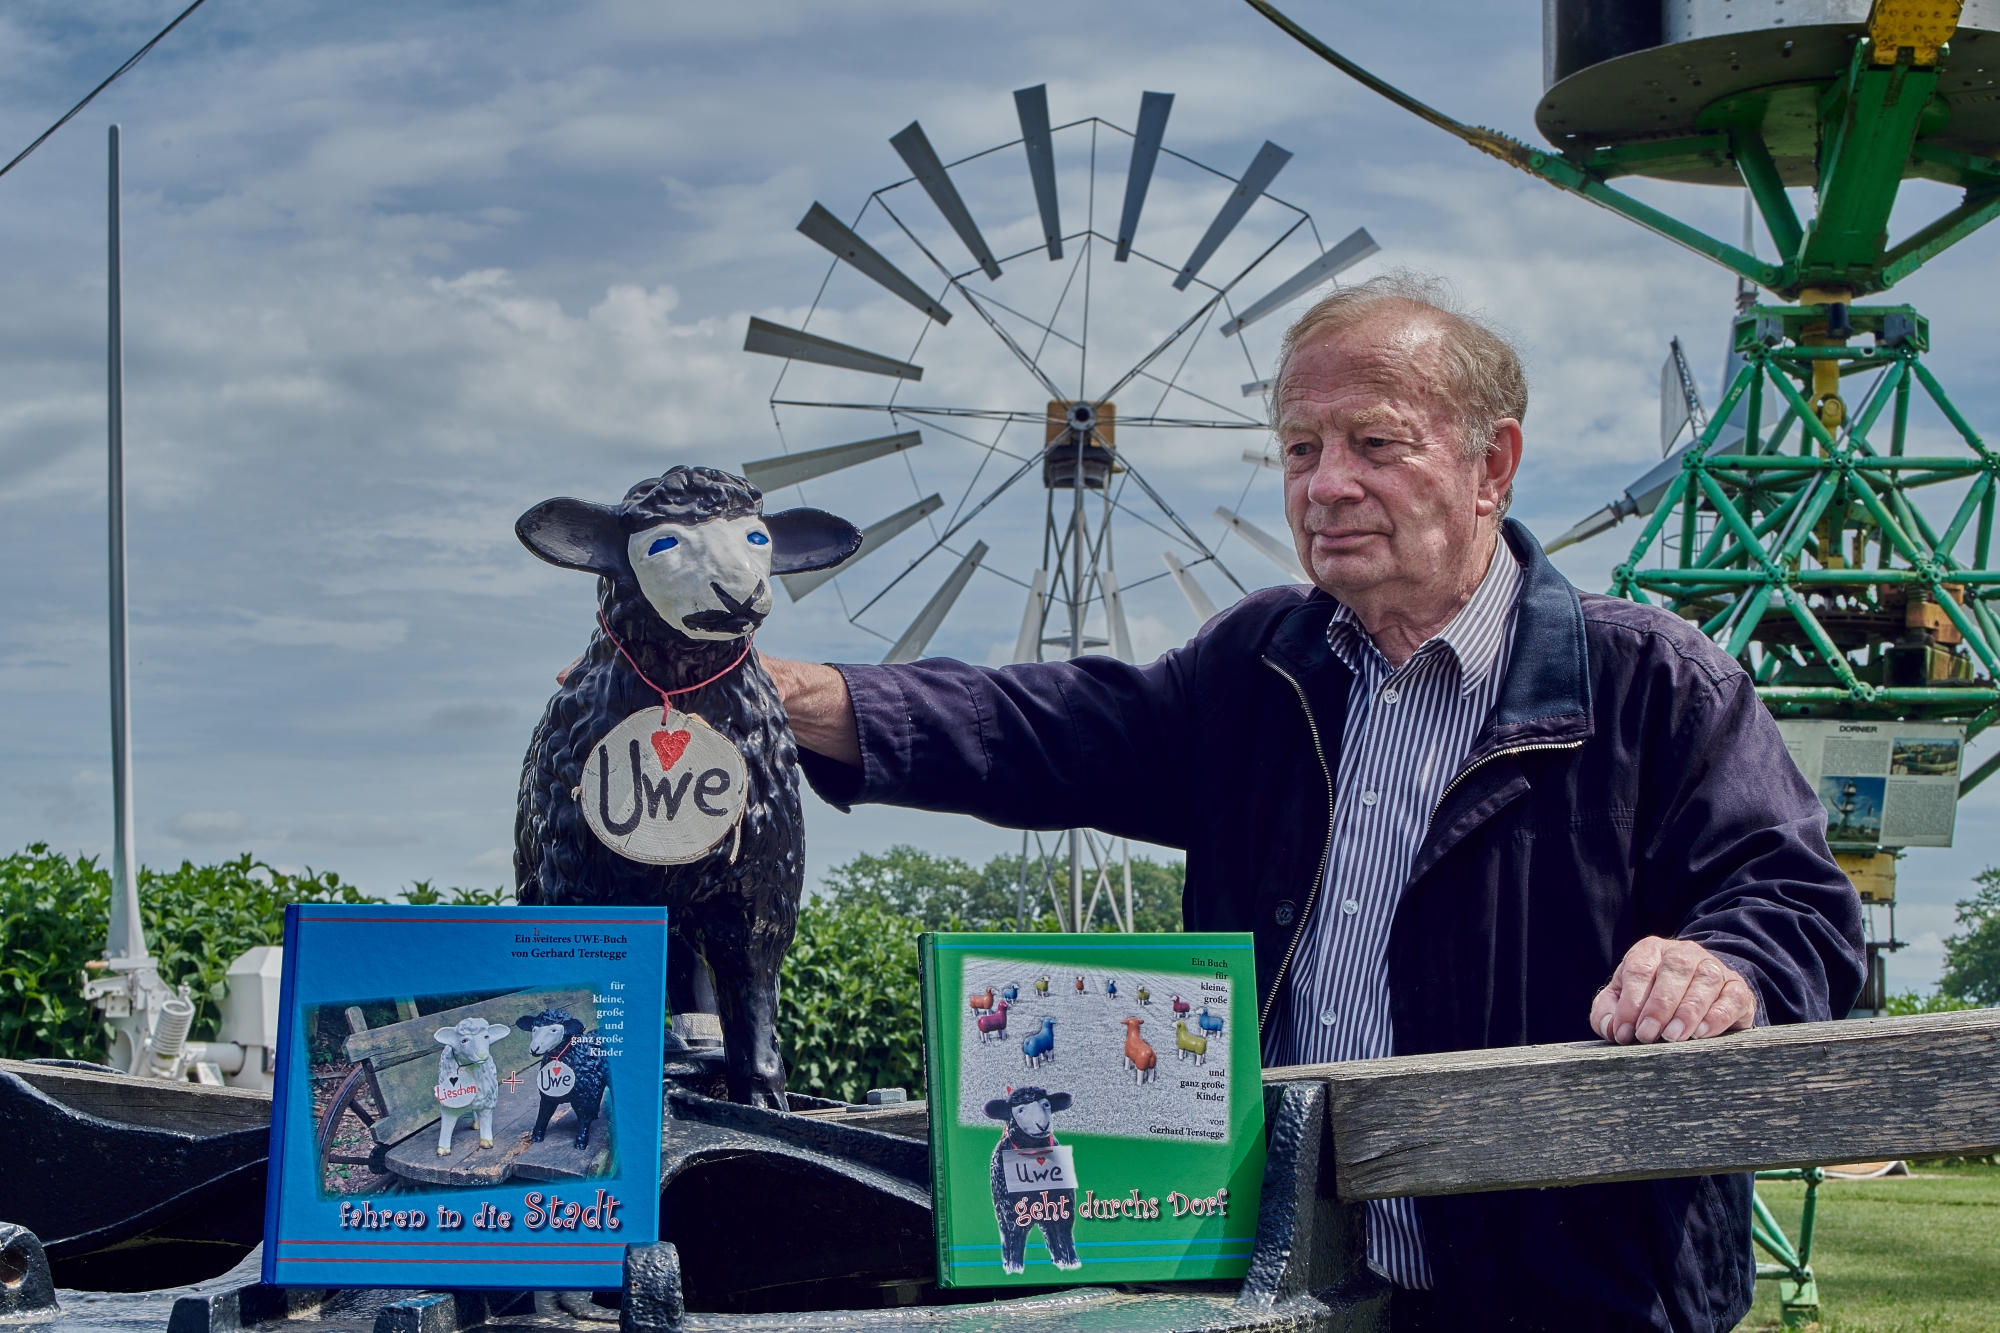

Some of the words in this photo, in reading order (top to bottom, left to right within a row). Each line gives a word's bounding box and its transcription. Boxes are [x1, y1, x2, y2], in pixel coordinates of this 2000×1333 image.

[1839, 725, 1878, 733] DORNIER
[599, 739, 731, 836] Uwe
[515, 934, 531, 943] Ein
[574, 934, 628, 944] UWE-Buch
[531, 948, 575, 958] Gerhard
[578, 948, 628, 960] Terstegge
[1191, 957, 1205, 966] Ein
[1207, 958, 1228, 968] Buch
[1215, 971, 1228, 980] für
[610, 981, 626, 990] für
[1200, 982, 1228, 993] kleine,
[593, 994, 625, 1005] kleine,
[1203, 996, 1228, 1005] große
[596, 1008, 625, 1019] große
[605, 1021, 624, 1030] und
[571, 1035, 594, 1046] ganz
[596, 1034, 624, 1046] große
[589, 1047, 624, 1057] Kinder
[1209, 1069, 1225, 1077] und
[436, 1085, 477, 1101] Lieschen
[540, 1069, 571, 1092] Uwe
[1180, 1081, 1200, 1089] ganz
[1201, 1081, 1225, 1090] große
[1196, 1092, 1225, 1102] Kinder
[1149, 1125, 1184, 1136] Gerhard
[1186, 1127, 1225, 1140] Terstegge
[1016, 1162, 1064, 1184] Uwe
[339, 1201, 426, 1229] fahren
[436, 1204, 462, 1228] in
[472, 1202, 512, 1229] die
[524, 1189, 620, 1229] Stadt
[1014, 1190, 1070, 1227] geht
[1078, 1188, 1160, 1219] durchs
[1167, 1187, 1228, 1217] Dorf
